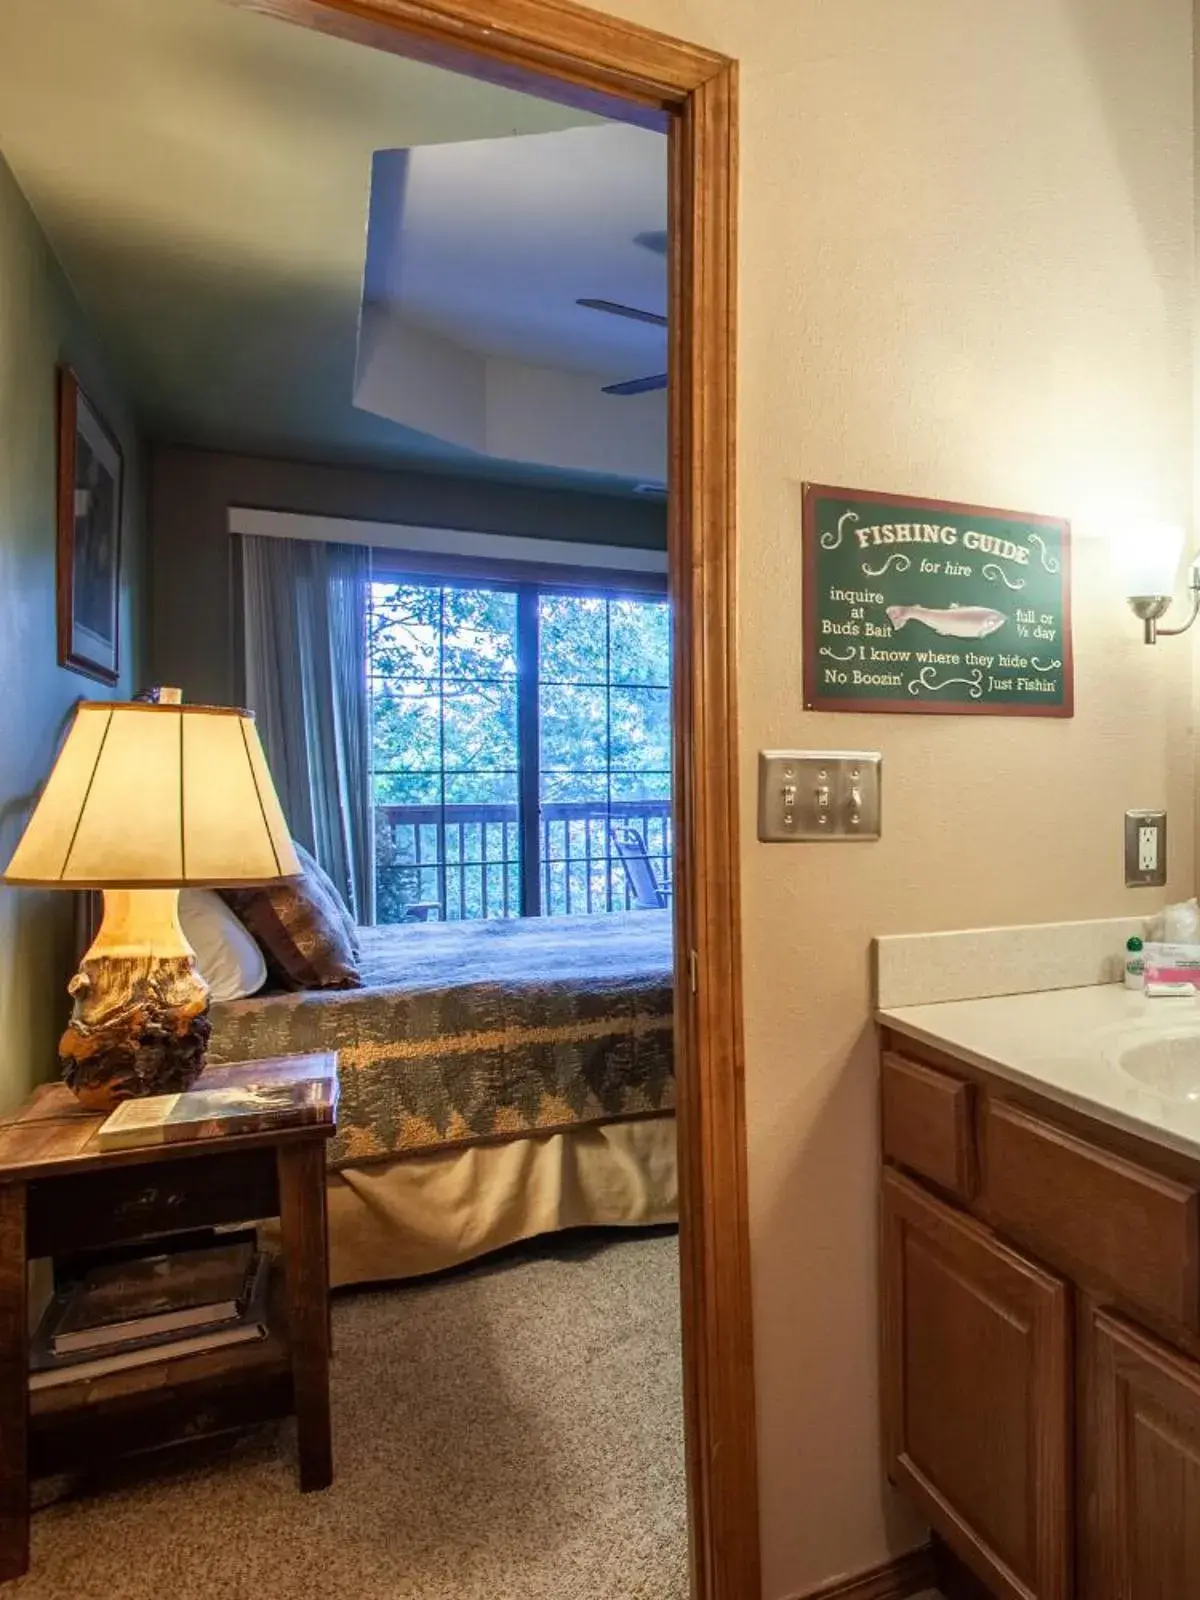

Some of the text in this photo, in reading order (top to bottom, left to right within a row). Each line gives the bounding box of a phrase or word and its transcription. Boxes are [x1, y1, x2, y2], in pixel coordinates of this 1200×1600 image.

[855, 523, 1030, 565] FISHING GUIDE
[919, 558, 972, 576] for hire
[830, 586, 884, 605] inquire
[850, 606, 864, 619] at
[1016, 608, 1054, 625] full or
[865, 621, 894, 638] Bait
[1033, 625, 1056, 641] day
[859, 646, 1028, 668] I know where they hide
[824, 669, 848, 684] No
[987, 676, 1012, 692] Just
